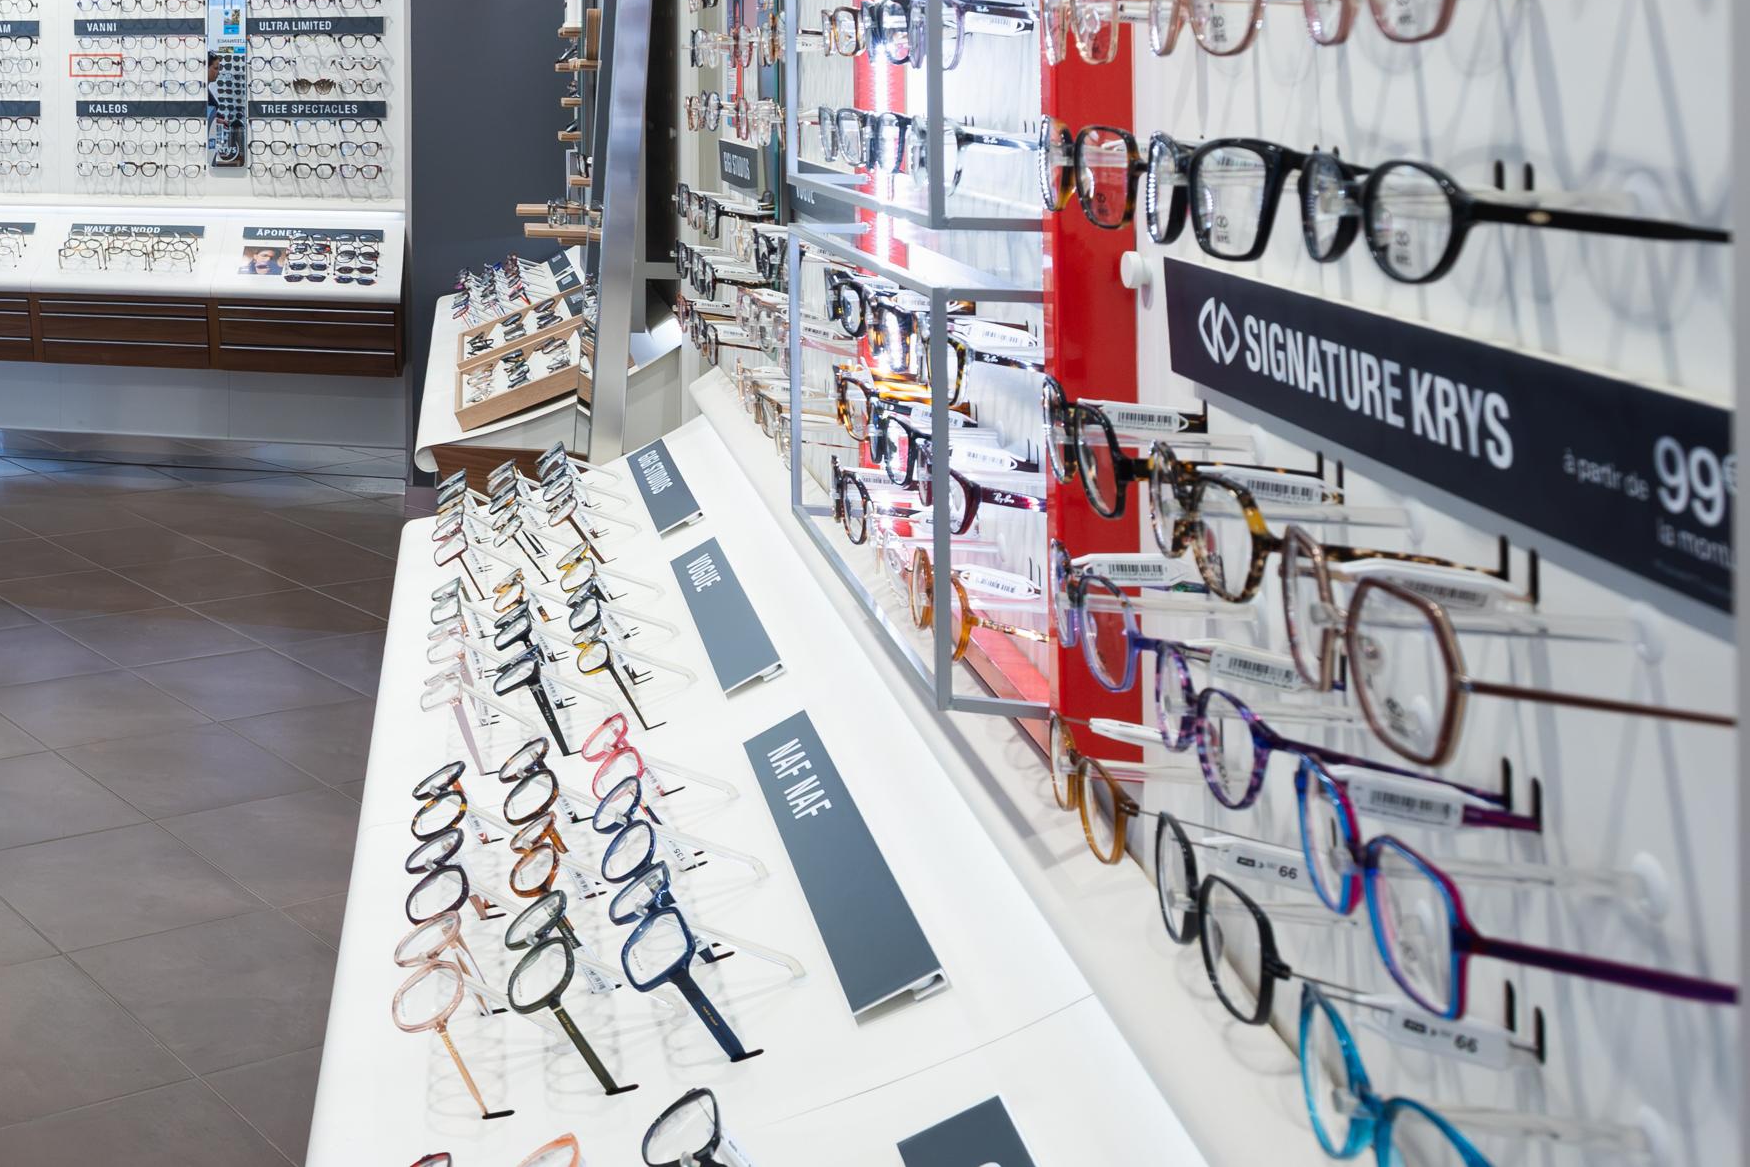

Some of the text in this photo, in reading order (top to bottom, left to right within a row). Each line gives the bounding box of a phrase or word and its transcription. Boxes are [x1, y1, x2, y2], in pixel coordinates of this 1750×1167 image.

[86, 23, 117, 32] VANNI
[258, 20, 332, 31] ULTRA LIMITED
[88, 104, 128, 114] KALEOS
[261, 104, 358, 114] TREE SPECTACLES
[83, 224, 161, 234] WAVE OF WOOD
[1243, 314, 1514, 470] SIGNATURE KRYS
[643, 461, 674, 495] STUDIOS
[685, 552, 722, 593] VOGUE
[767, 737, 832, 820] NAF NAF
